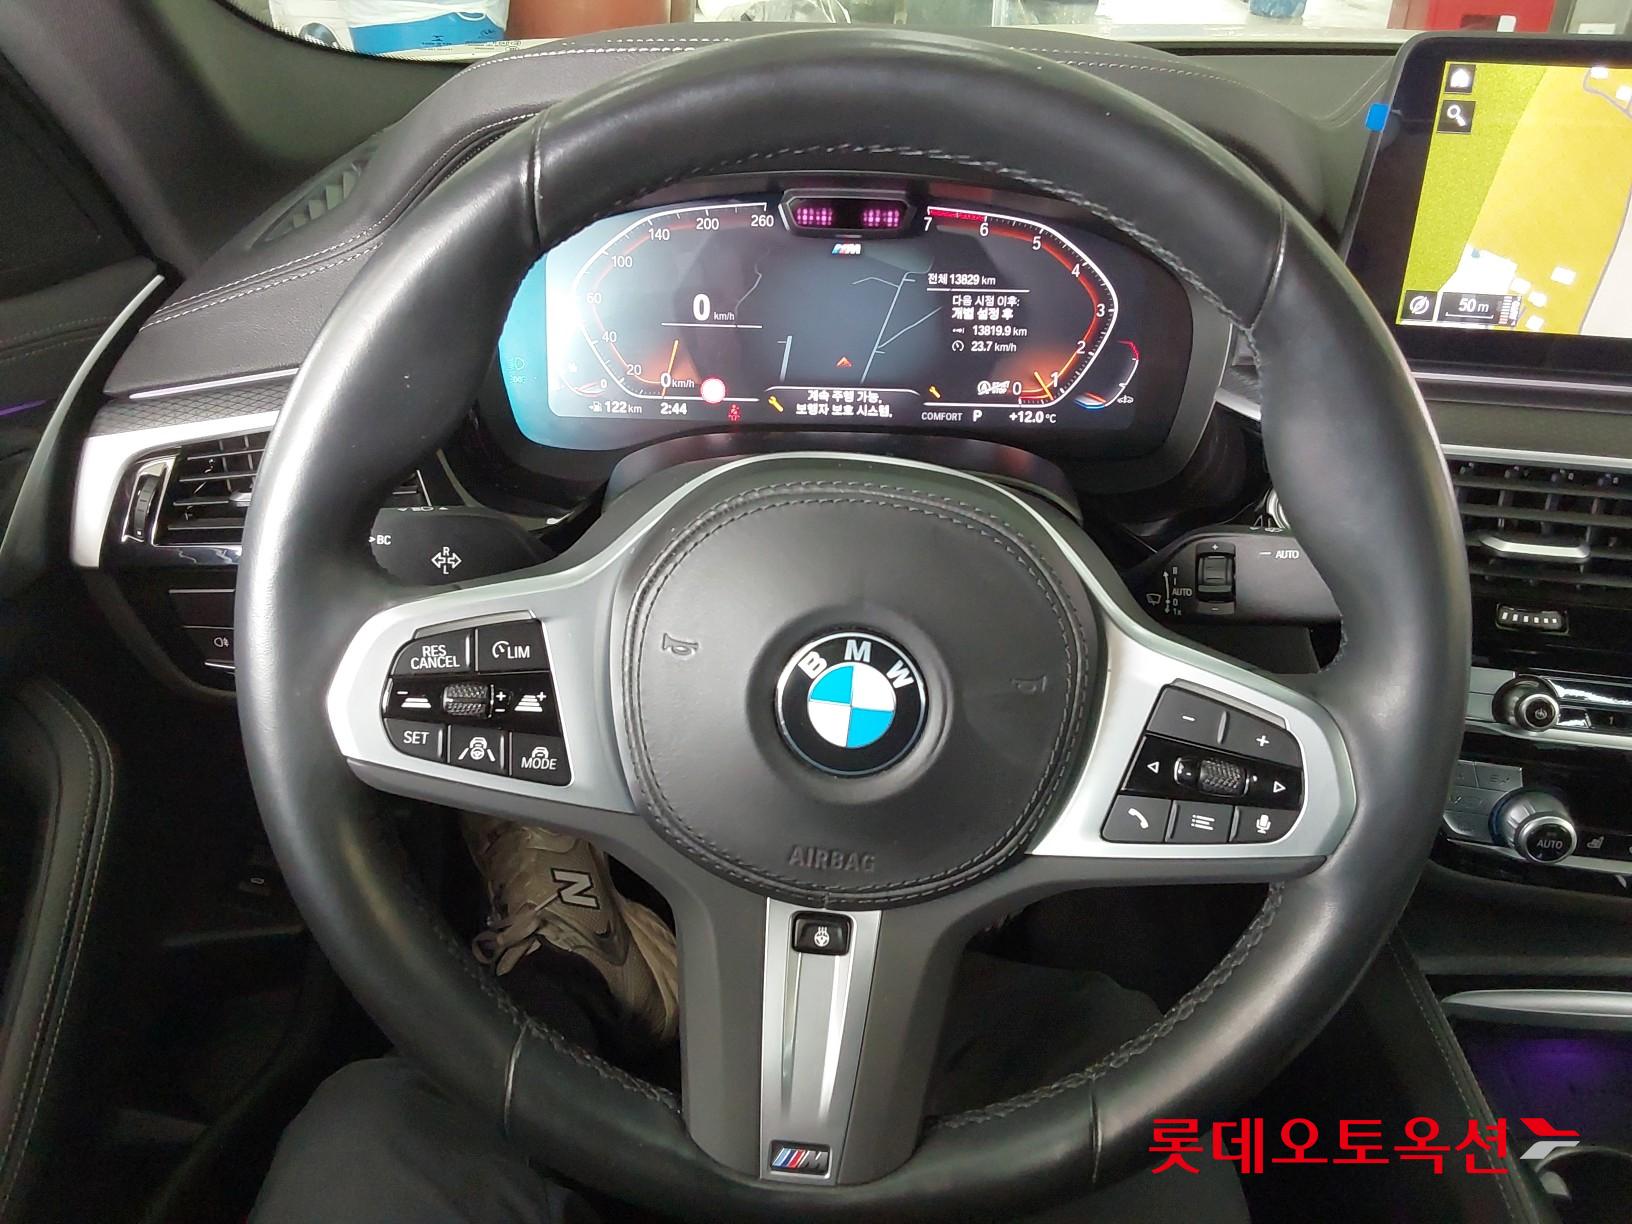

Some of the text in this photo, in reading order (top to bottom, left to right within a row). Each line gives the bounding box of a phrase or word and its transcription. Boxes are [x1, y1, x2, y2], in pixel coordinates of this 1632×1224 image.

[695, 218, 720, 231] 200
[751, 214, 775, 228] 260
[924, 217, 933, 232] 7
[648, 227, 671, 242] 140
[979, 222, 989, 237] 6
[1032, 235, 1042, 251] 5
[611, 255, 634, 269] 100
[1071, 263, 1081, 278] 4
[928, 273, 996, 285] 전체 13829 km
[693, 294, 735, 321] 0 km/h
[952, 295, 972, 306] 다음
[974, 295, 995, 307] 시점
[1459, 298, 1490, 312] 50 m
[1002, 308, 1014, 320] 후
[1096, 304, 1106, 317] 3
[972, 325, 1028, 336] 13819.9 km
[602, 332, 617, 344] 40
[970, 341, 1017, 352] 23.7 km/h
[1076, 341, 1086, 355] 2
[626, 364, 642, 376] 20
[600, 379, 607, 388] 0
[660, 373, 695, 388] 0 km/h
[1050, 372, 1059, 387] 1
[1012, 381, 1022, 395] 0
[605, 401, 643, 413] 122 km
[660, 402, 687, 415] 2:44
[921, 411, 963, 421] COMFORT
[972, 409, 983, 422] P
[1009, 410, 1044, 423] +12.0
[377, 534, 392, 546] BC
[442, 546, 451, 556] R
[1275, 550, 1300, 559] AUTO
[442, 565, 449, 575] L
[1172, 587, 1193, 597] AUTO
[422, 645, 447, 657] RES
[507, 647, 530, 659] LIM
[410, 656, 460, 670] CANCEL
[797, 639, 914, 690] BMW
[403, 731, 429, 745] SET
[520, 756, 557, 770] MODE
[1536, 839, 1564, 850] AUTO
[788, 848, 876, 873] AIRBAG
